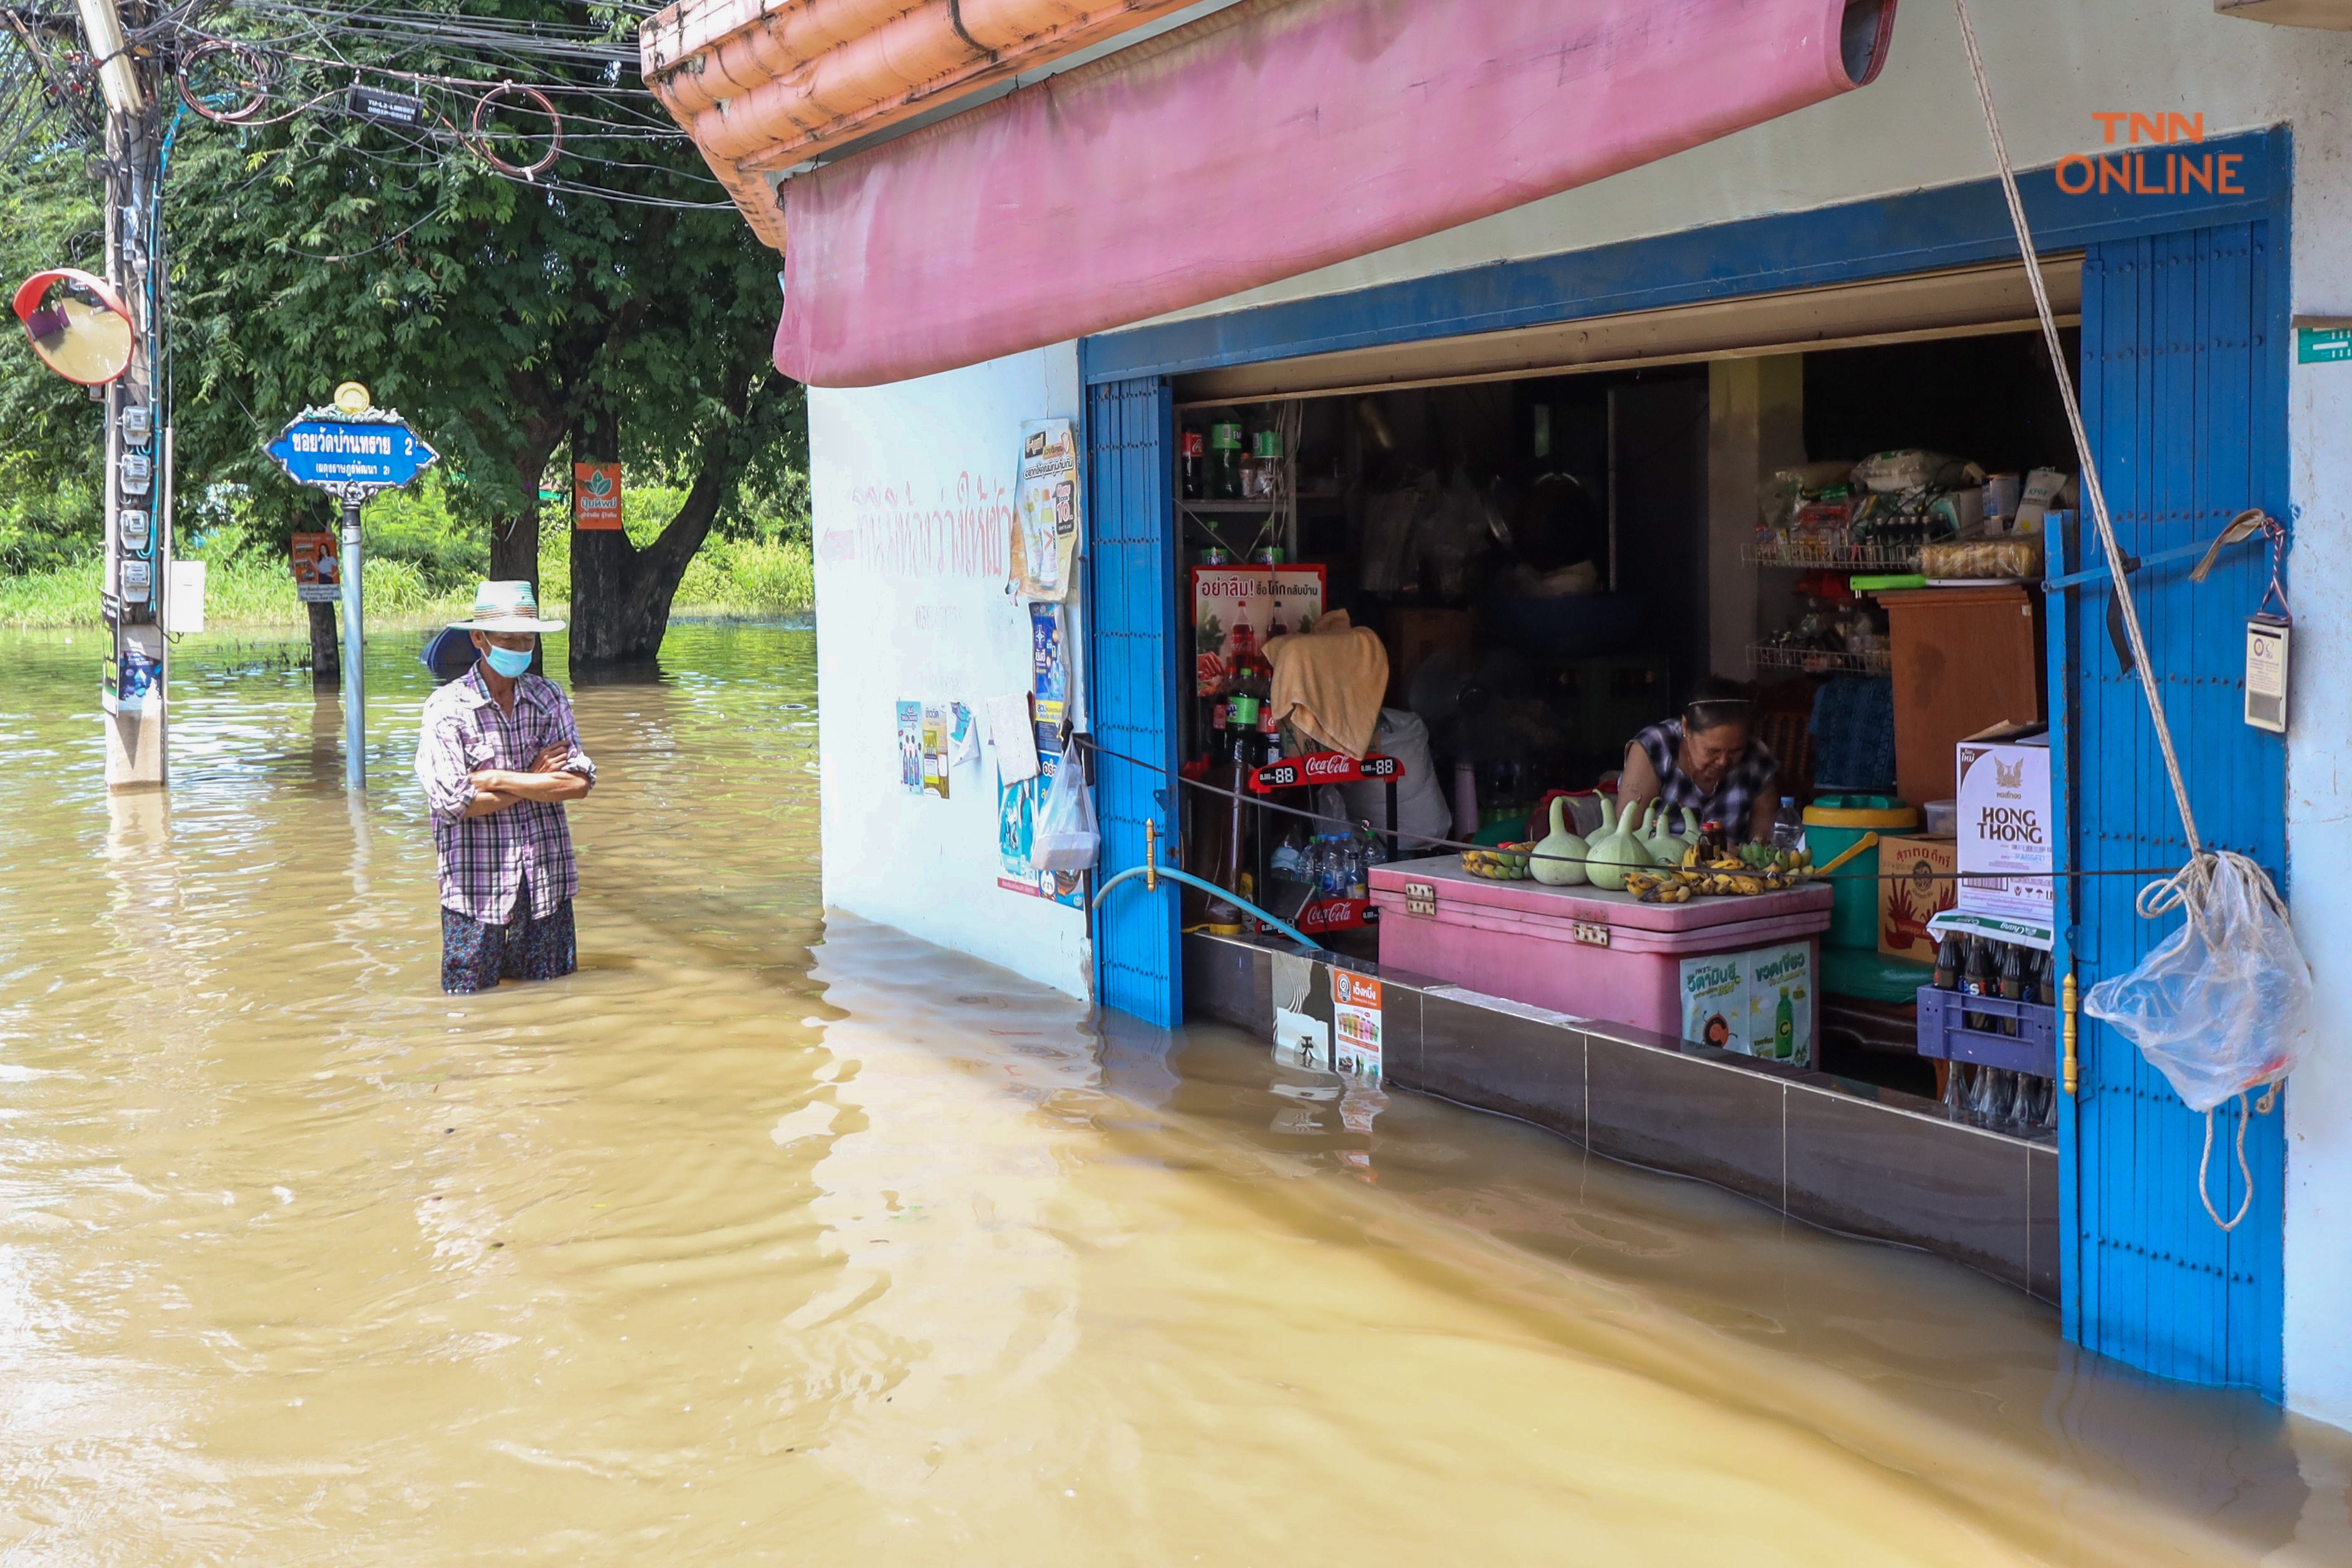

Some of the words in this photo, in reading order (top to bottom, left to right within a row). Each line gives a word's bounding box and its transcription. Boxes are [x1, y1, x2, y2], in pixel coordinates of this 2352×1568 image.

[405, 438, 413, 455] 2
[1202, 576, 1254, 597] อย่าลืม!
[1287, 584, 1318, 596] กลับบ้าน
[1306, 755, 1349, 776] Coca-Cola
[1982, 807, 2036, 827] HONG
[1977, 823, 2043, 843] THONG
[1307, 902, 1351, 925] Coca-Cola
[2000, 922, 2025, 935] Chang
